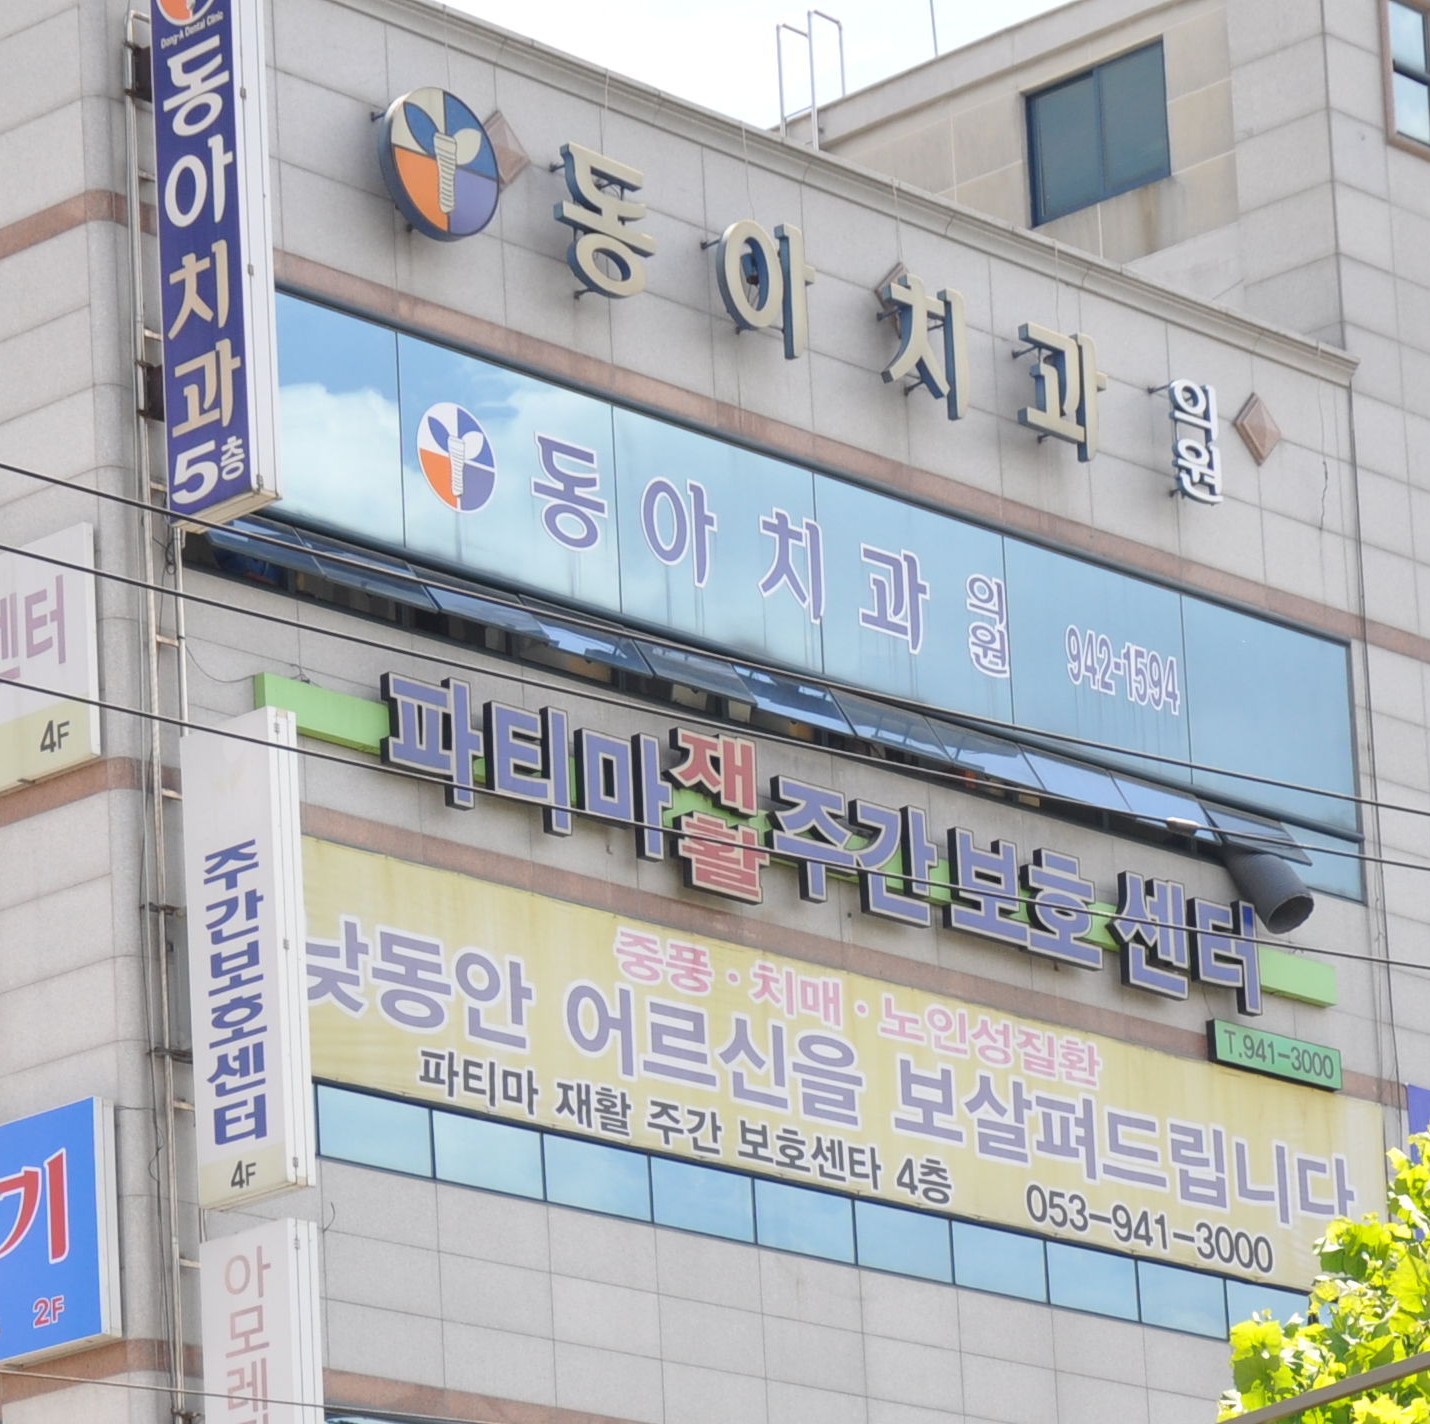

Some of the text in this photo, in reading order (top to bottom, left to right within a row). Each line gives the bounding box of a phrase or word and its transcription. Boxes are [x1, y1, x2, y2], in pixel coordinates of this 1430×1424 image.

[161, 34, 242, 437] 동아치과
[172, 435, 245, 504] 5층
[1169, 378, 1224, 505] 의원
[531, 431, 930, 656] 동아치과
[966, 573, 1010, 677] 의원
[1064, 625, 1180, 716] 942-1594
[40, 720, 71, 755] 4F
[380, 671, 674, 862] 파티마
[203, 838, 268, 1146] 주간보호센터
[617, 928, 1101, 1088] 중풍 치매 노인성질환
[567, 983, 864, 1128] 어르신을
[893, 1055, 1356, 1226] 보살펴드립니다
[1223, 1027, 1335, 1082] T.941-3000
[230, 1159, 257, 1189] 4F
[419, 1049, 538, 1115] 파티마
[555, 1080, 632, 1134] 재활
[647, 1099, 722, 1156] 주간
[895, 1157, 952, 1205] 4층
[1025, 1183, 1273, 1275] 053-941-3000
[33, 1297, 65, 1329] 2F
